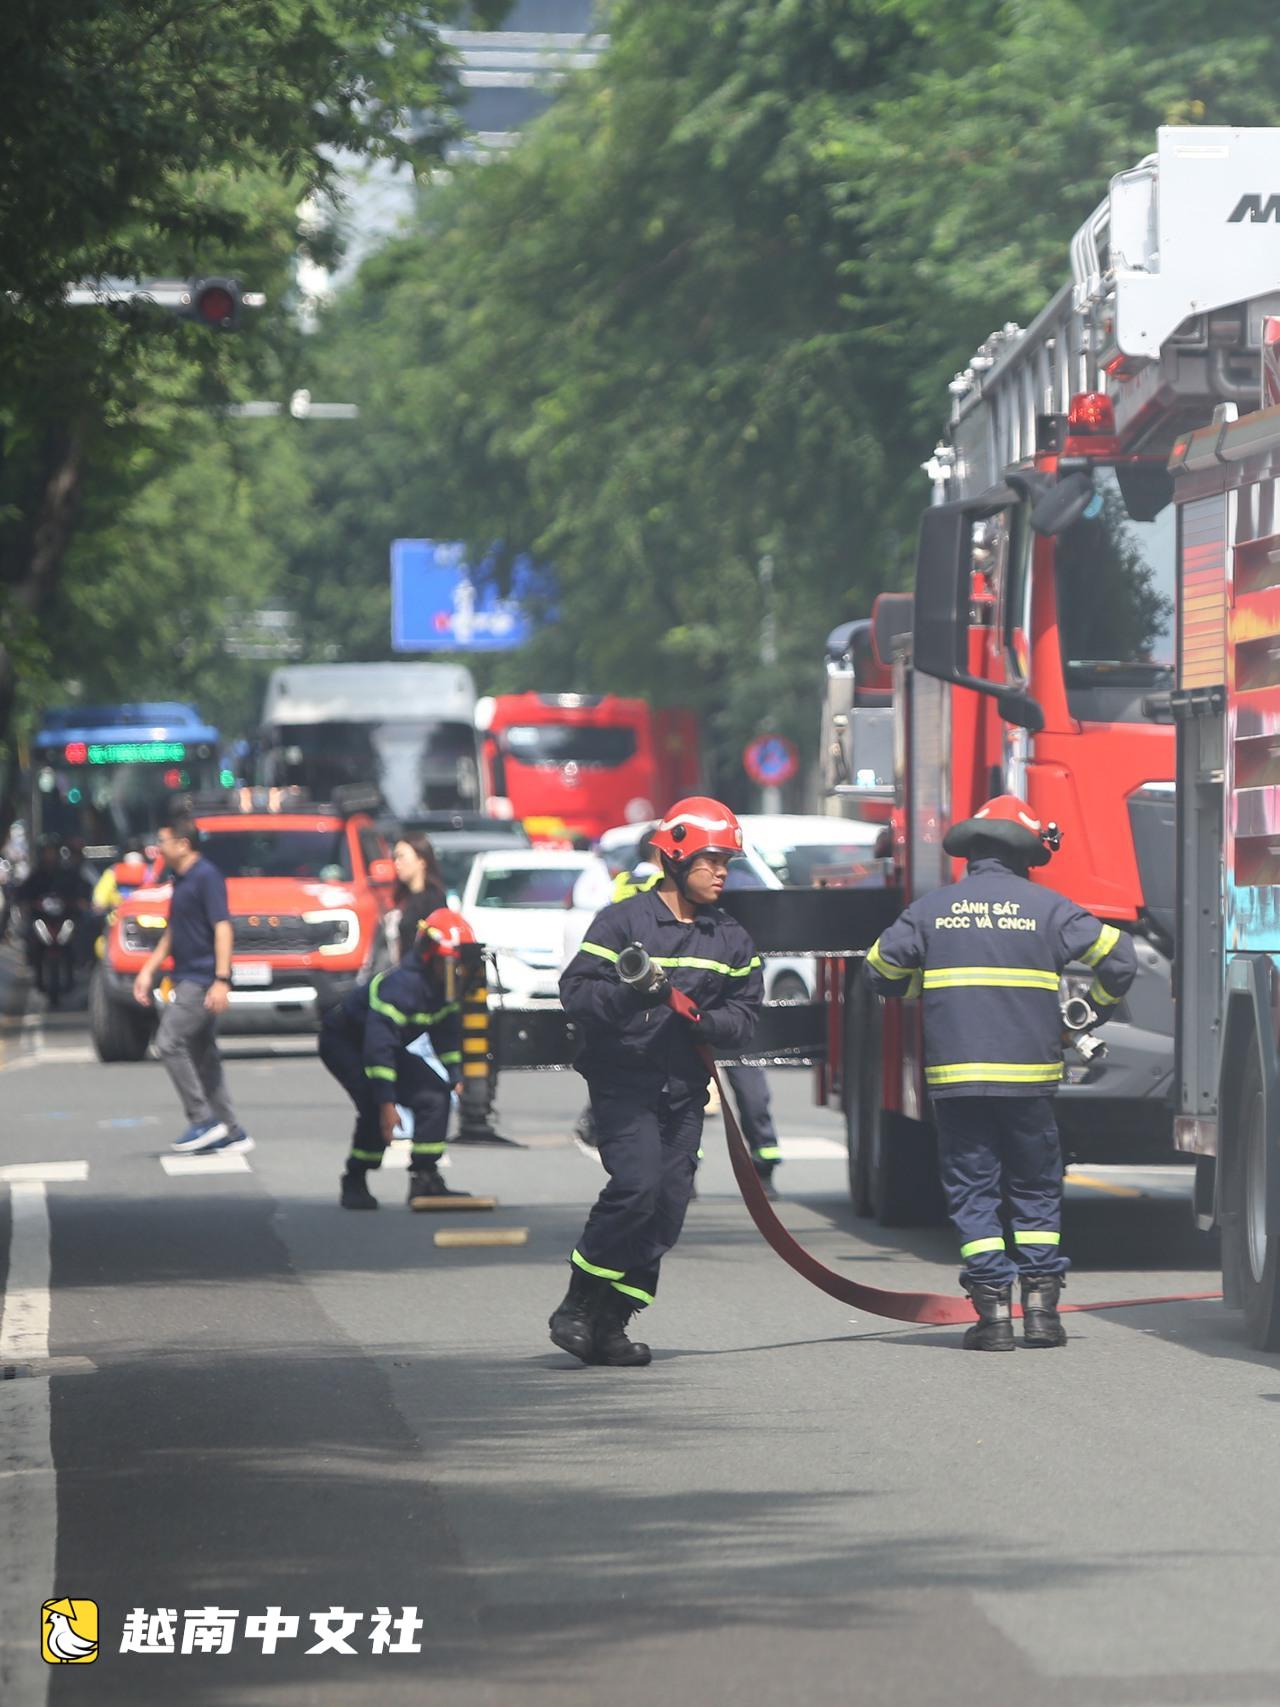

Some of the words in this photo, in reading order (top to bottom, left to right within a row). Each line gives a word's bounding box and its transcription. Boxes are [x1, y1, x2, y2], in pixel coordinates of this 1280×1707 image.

[951, 899, 989, 915] CẢNH
[992, 901, 1020, 915] SÁT
[935, 917, 970, 929] PCCC
[975, 913, 993, 929] VÀ
[997, 917, 1036, 931] CNCH
